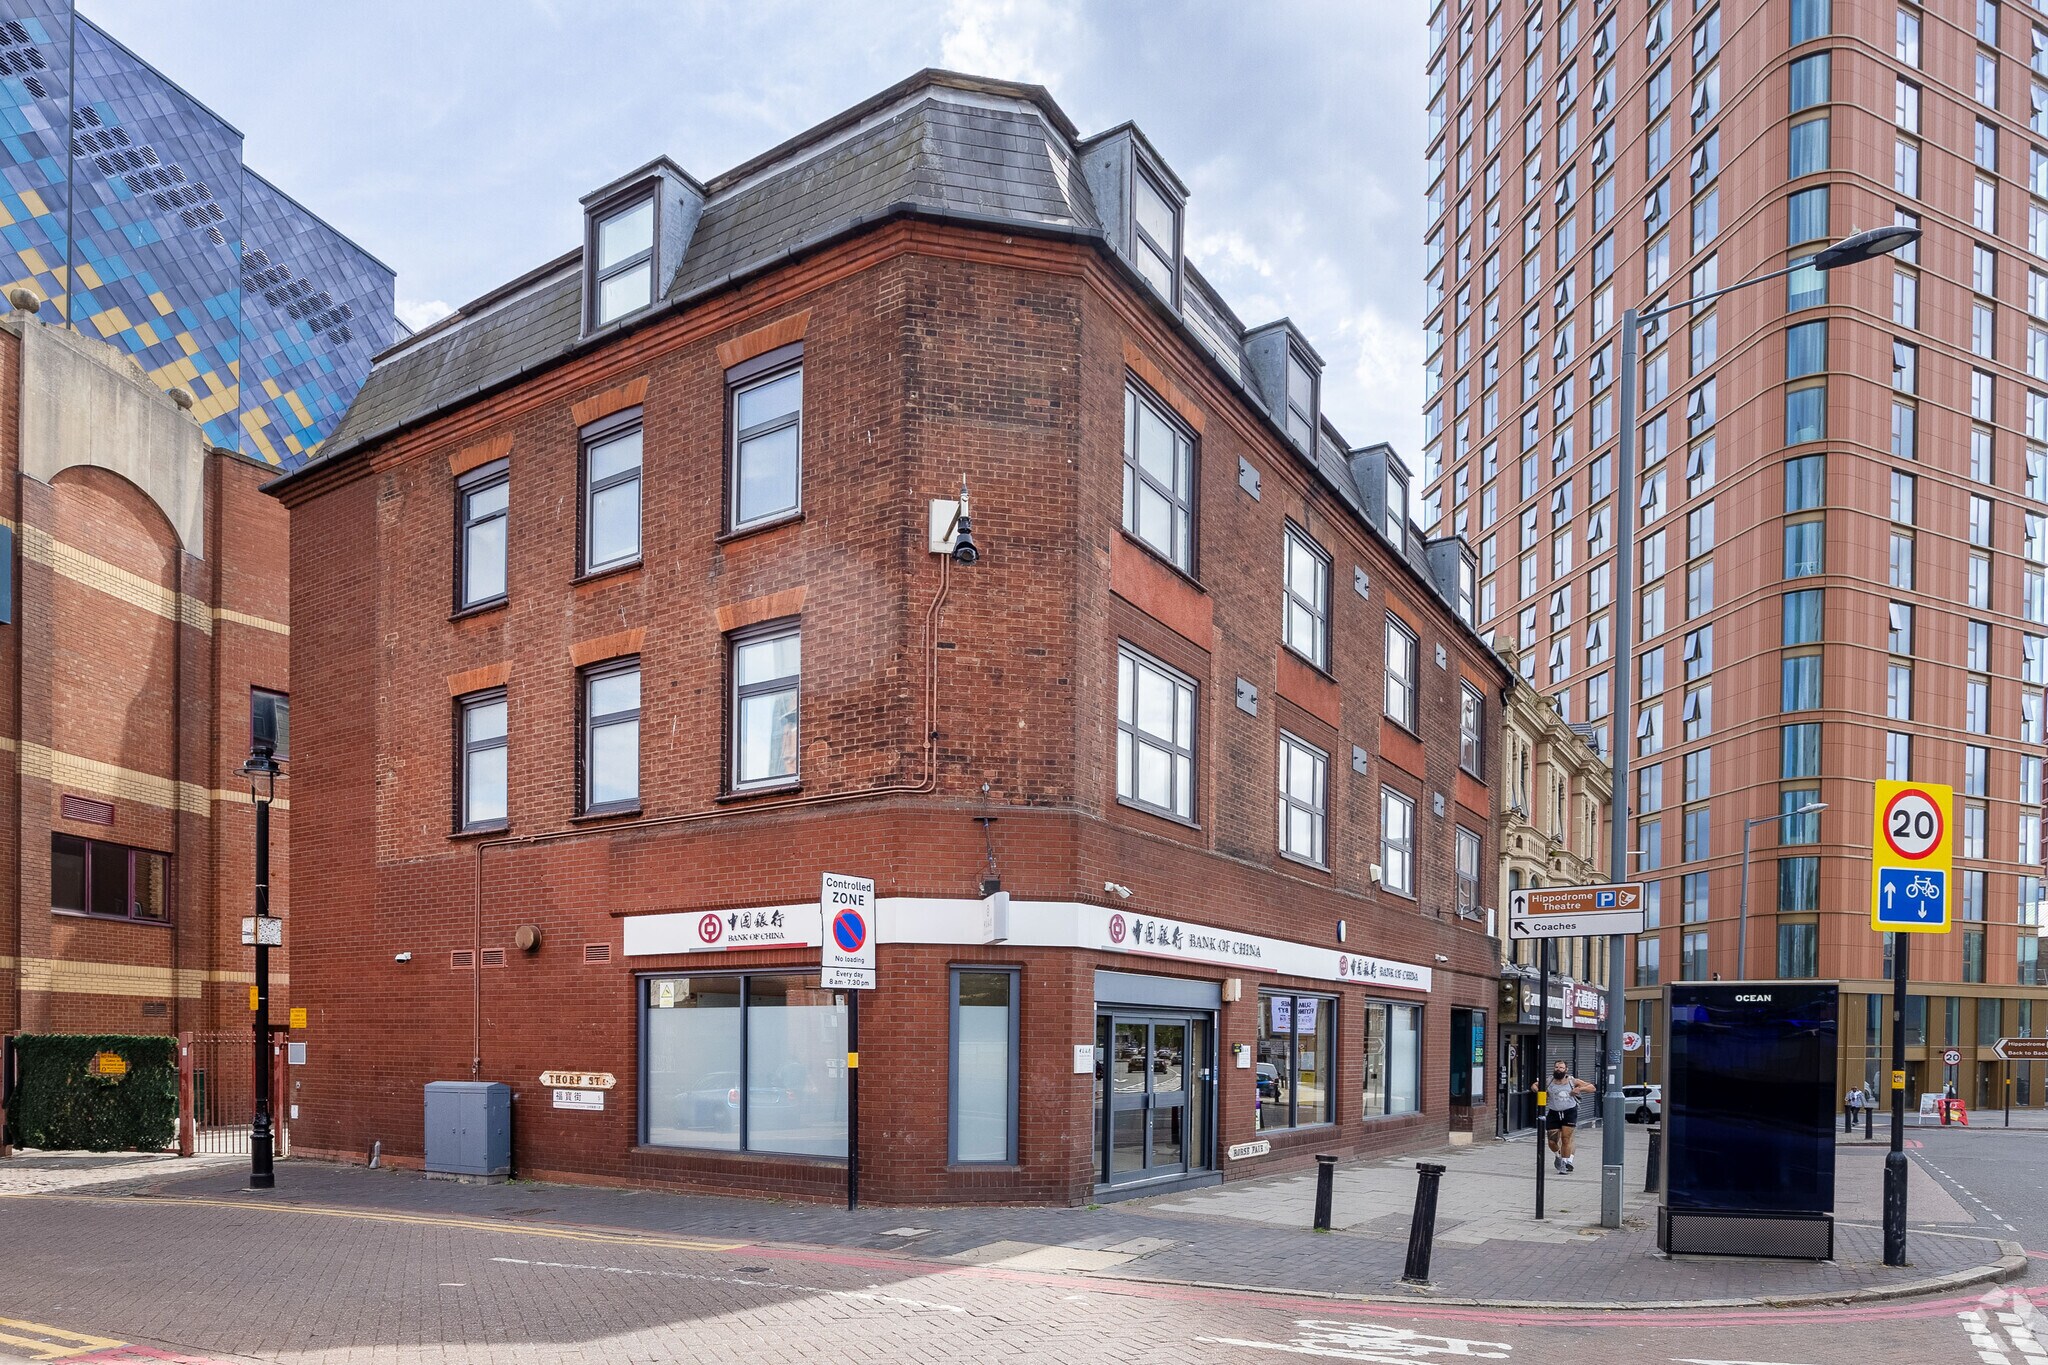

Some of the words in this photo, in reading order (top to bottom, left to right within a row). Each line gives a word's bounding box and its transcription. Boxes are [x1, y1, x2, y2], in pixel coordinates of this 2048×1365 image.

[1892, 809, 1934, 839] 20
[826, 877, 871, 892] Controlled
[832, 891, 865, 906] ZONE
[1531, 892, 1593, 903] Hippodrome
[1600, 892, 1613, 906] P
[1542, 902, 1581, 911] Theatre
[1533, 922, 1577, 931] Coaches
[728, 933, 748, 941] BANK
[760, 932, 785, 940] CHINA
[1189, 933, 1216, 951] BANK
[1217, 938, 1231, 952] OF
[1232, 942, 1261, 958] CHINA
[844, 956, 865, 964] loading
[836, 970, 852, 978] Every
[1379, 966, 1394, 978] BANK
[1735, 994, 1772, 1002] OCEAN
[1945, 1053, 1960, 1062] 20
[549, 1075, 582, 1085] THORP
